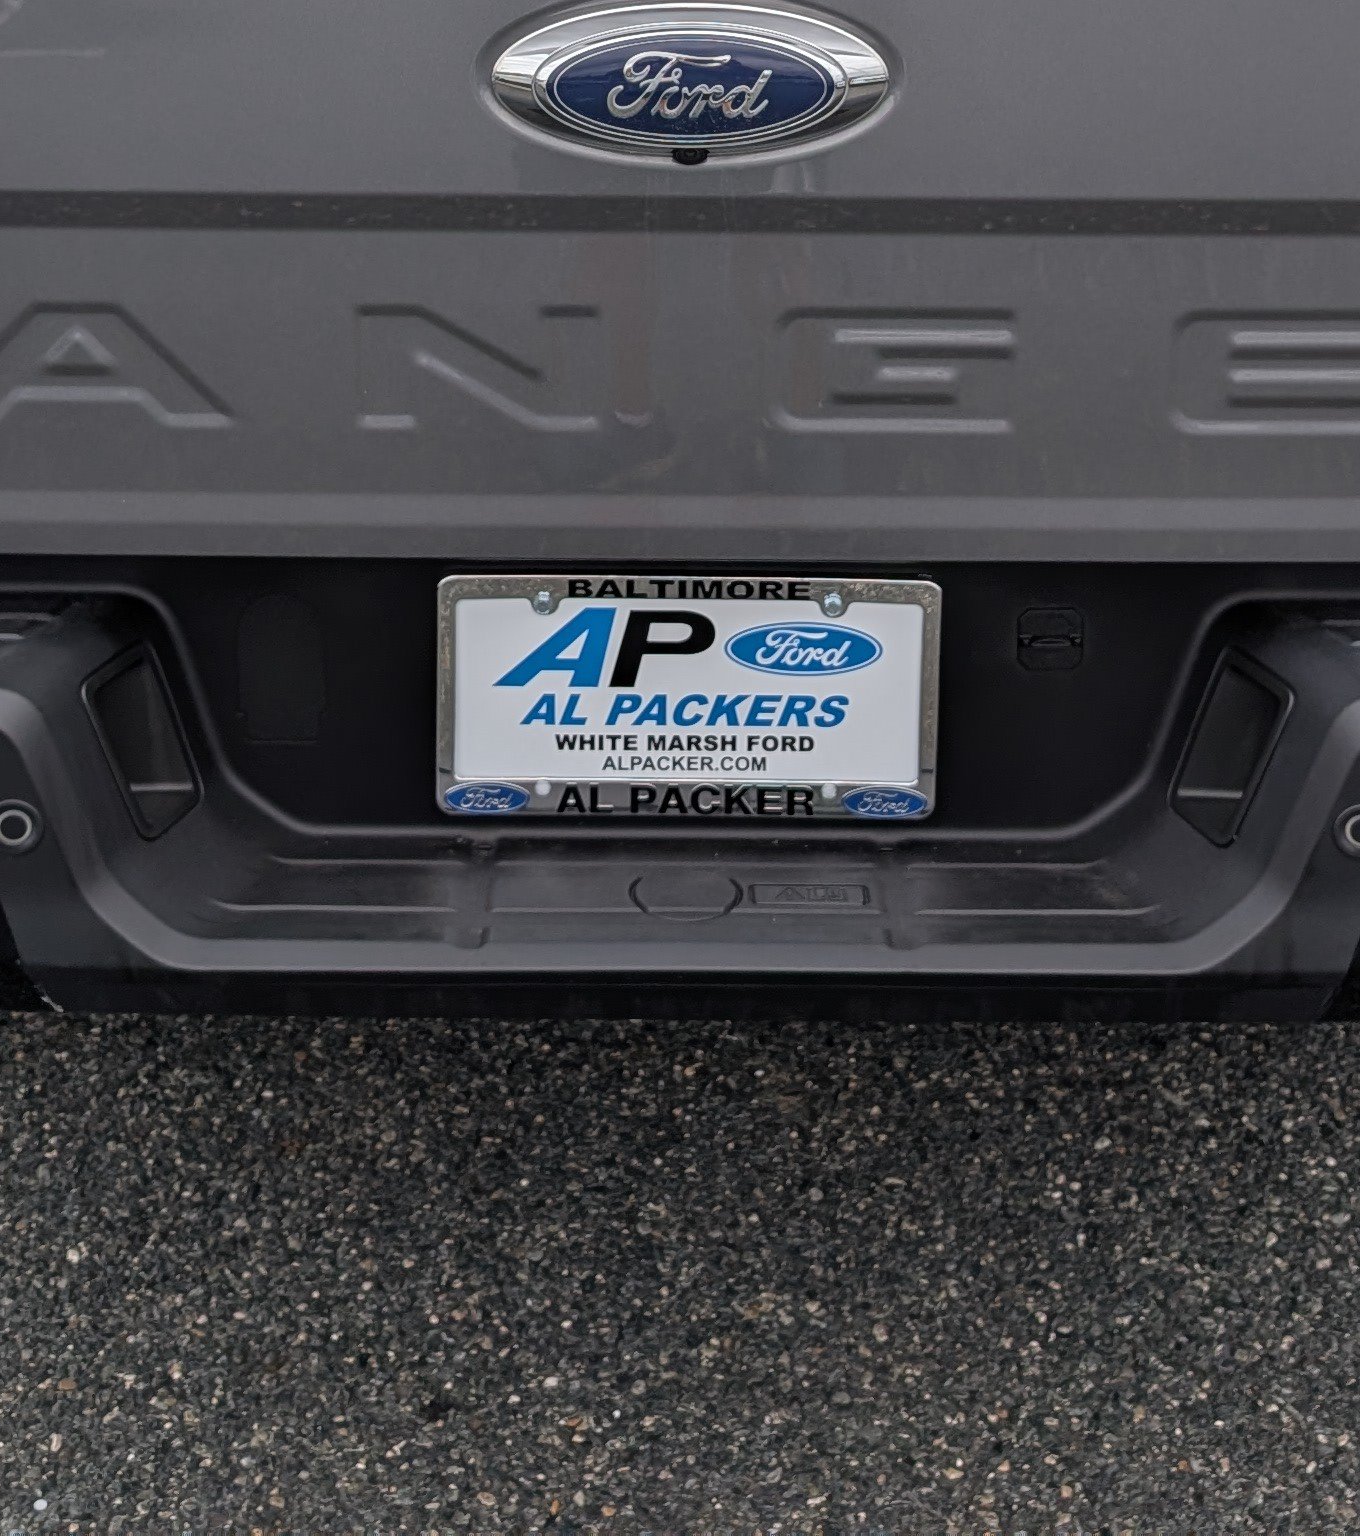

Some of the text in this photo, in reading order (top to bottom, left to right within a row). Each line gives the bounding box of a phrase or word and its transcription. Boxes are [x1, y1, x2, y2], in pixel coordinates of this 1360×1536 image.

[606, 50, 773, 120] Ford
[567, 578, 812, 600] BALTIMORE
[492, 607, 717, 688] AP
[755, 629, 852, 667] Ford
[520, 693, 850, 728] AL PACKERS
[555, 733, 815, 752] WHITE MARSH FORD
[601, 755, 768, 772] ALPACKER.COM
[459, 786, 515, 810] Ford
[556, 782, 815, 816] AL PACKER
[856, 790, 913, 814] Ford
